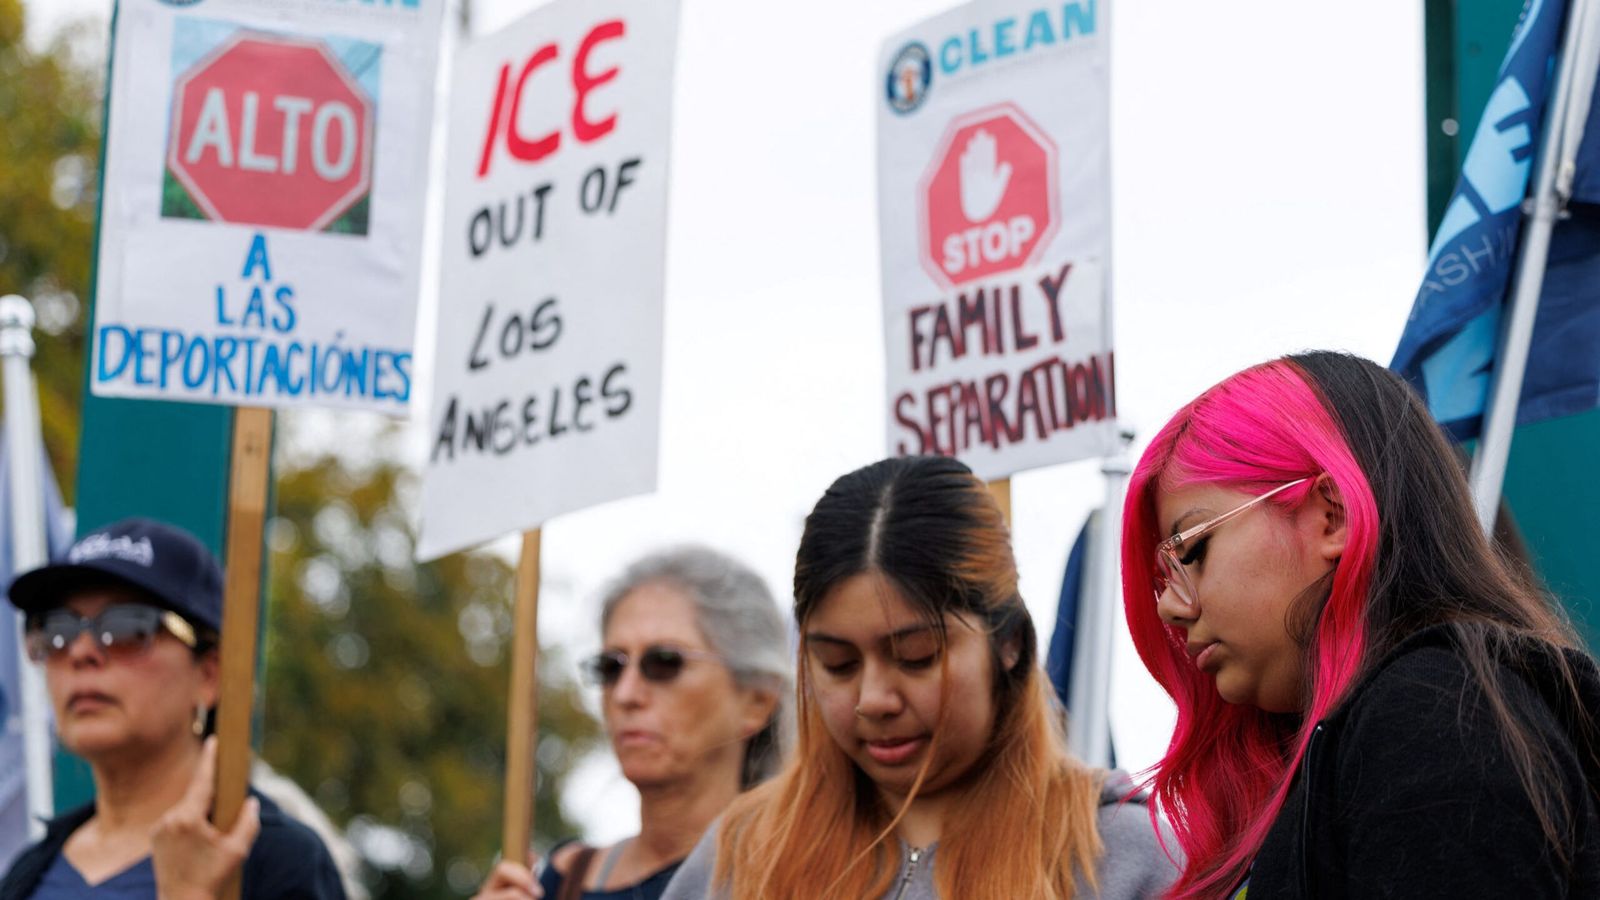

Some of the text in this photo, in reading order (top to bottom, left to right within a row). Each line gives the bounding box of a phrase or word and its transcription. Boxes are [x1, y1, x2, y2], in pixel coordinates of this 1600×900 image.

[939, 0, 1097, 74] CLEAN
[185, 87, 358, 181] ALTO
[477, 20, 625, 178] ICE
[468, 154, 642, 257] OUT OF
[943, 214, 1035, 274] STOP
[242, 233, 271, 281] A
[216, 284, 296, 332] LAS
[467, 296, 563, 371] LOS
[908, 263, 1072, 371] FAMILY
[430, 363, 632, 464] ANGELES
[894, 351, 1117, 457] SEPARATION
